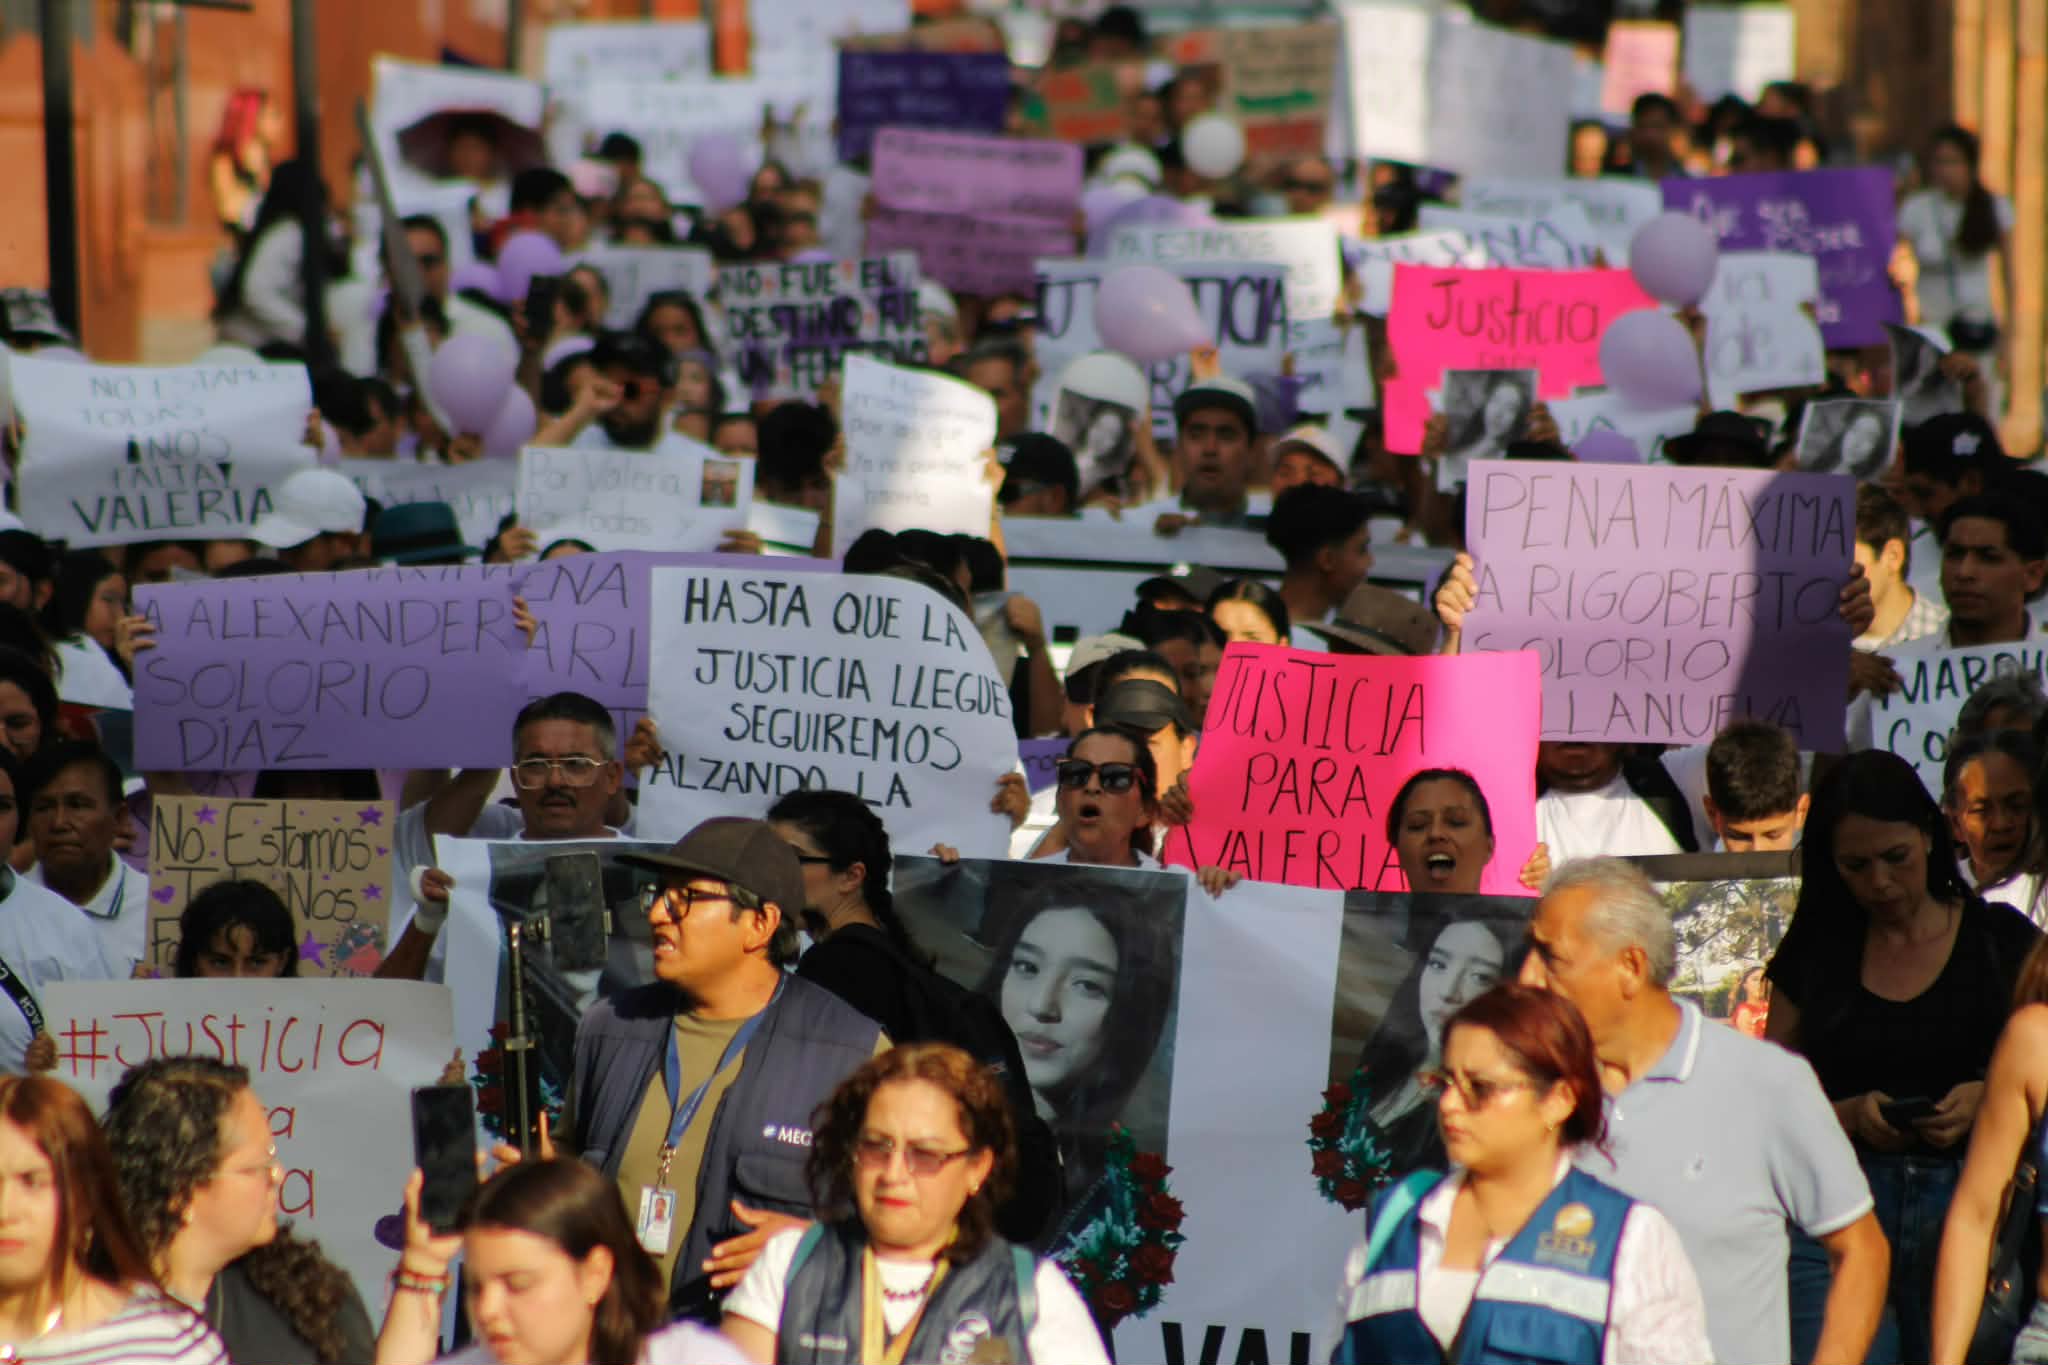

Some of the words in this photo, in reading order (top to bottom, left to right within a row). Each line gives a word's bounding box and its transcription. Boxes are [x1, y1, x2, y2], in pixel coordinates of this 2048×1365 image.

[721, 267, 762, 297] NO
[780, 262, 838, 296] FUE
[860, 256, 895, 290] EL
[727, 296, 863, 339] DESTINO
[1427, 276, 1600, 348] Justicia
[89, 375, 137, 399] NO
[70, 486, 275, 533] VALERIA
[1481, 471, 1640, 550] PENA
[1664, 477, 1846, 558] MÁXIMA
[143, 598, 164, 635] A
[186, 596, 513, 656] ALEXANDER
[683, 577, 811, 628] HASTA
[832, 591, 901, 640] QUE
[920, 602, 969, 652] LA
[1478, 564, 1504, 614] A
[1528, 564, 1842, 632] RIGOBERTO
[145, 656, 431, 721] SOLORIO
[694, 647, 872, 703] JUSTICIA
[890, 663, 1008, 719] LLEGUE
[1205, 654, 1425, 756] JUSTICIA
[723, 702, 962, 772] SEGUIREMOS
[648, 749, 829, 797] ALZANDO
[857, 769, 912, 808] LA
[1241, 751, 1373, 819] PARA
[155, 803, 206, 864] No
[224, 802, 372, 873] Estamos
[286, 871, 359, 922] Nos
